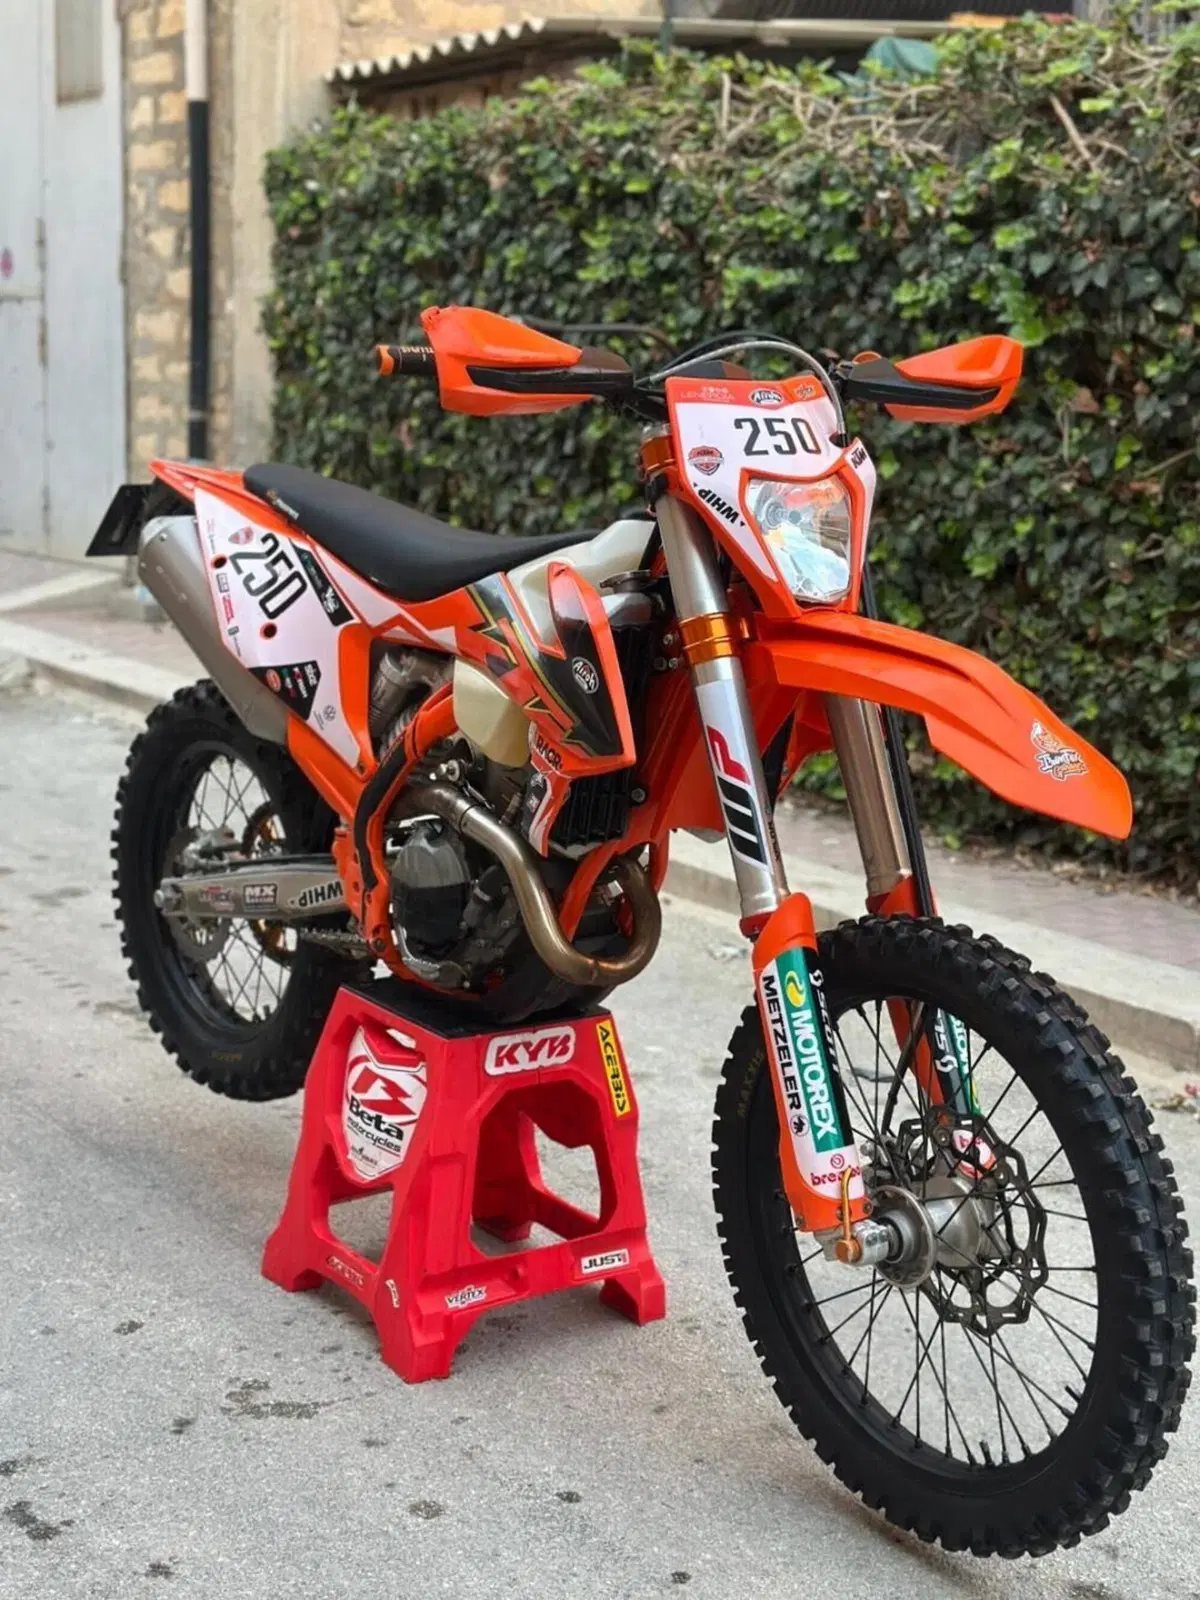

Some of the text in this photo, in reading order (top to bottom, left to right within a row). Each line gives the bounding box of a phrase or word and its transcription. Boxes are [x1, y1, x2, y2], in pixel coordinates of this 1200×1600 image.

[734, 418, 822, 456] 250
[851, 447, 866, 469] KTM
[698, 488, 739, 524] WHIP
[230, 533, 308, 620] 250
[298, 881, 344, 907] WHIP
[494, 1033, 571, 1069] KYB
[763, 975, 801, 1111] METZELER
[790, 1009, 838, 1140] MOTOREX
[347, 1116, 402, 1151] motorcycles
[350, 1095, 405, 1141] Beta
